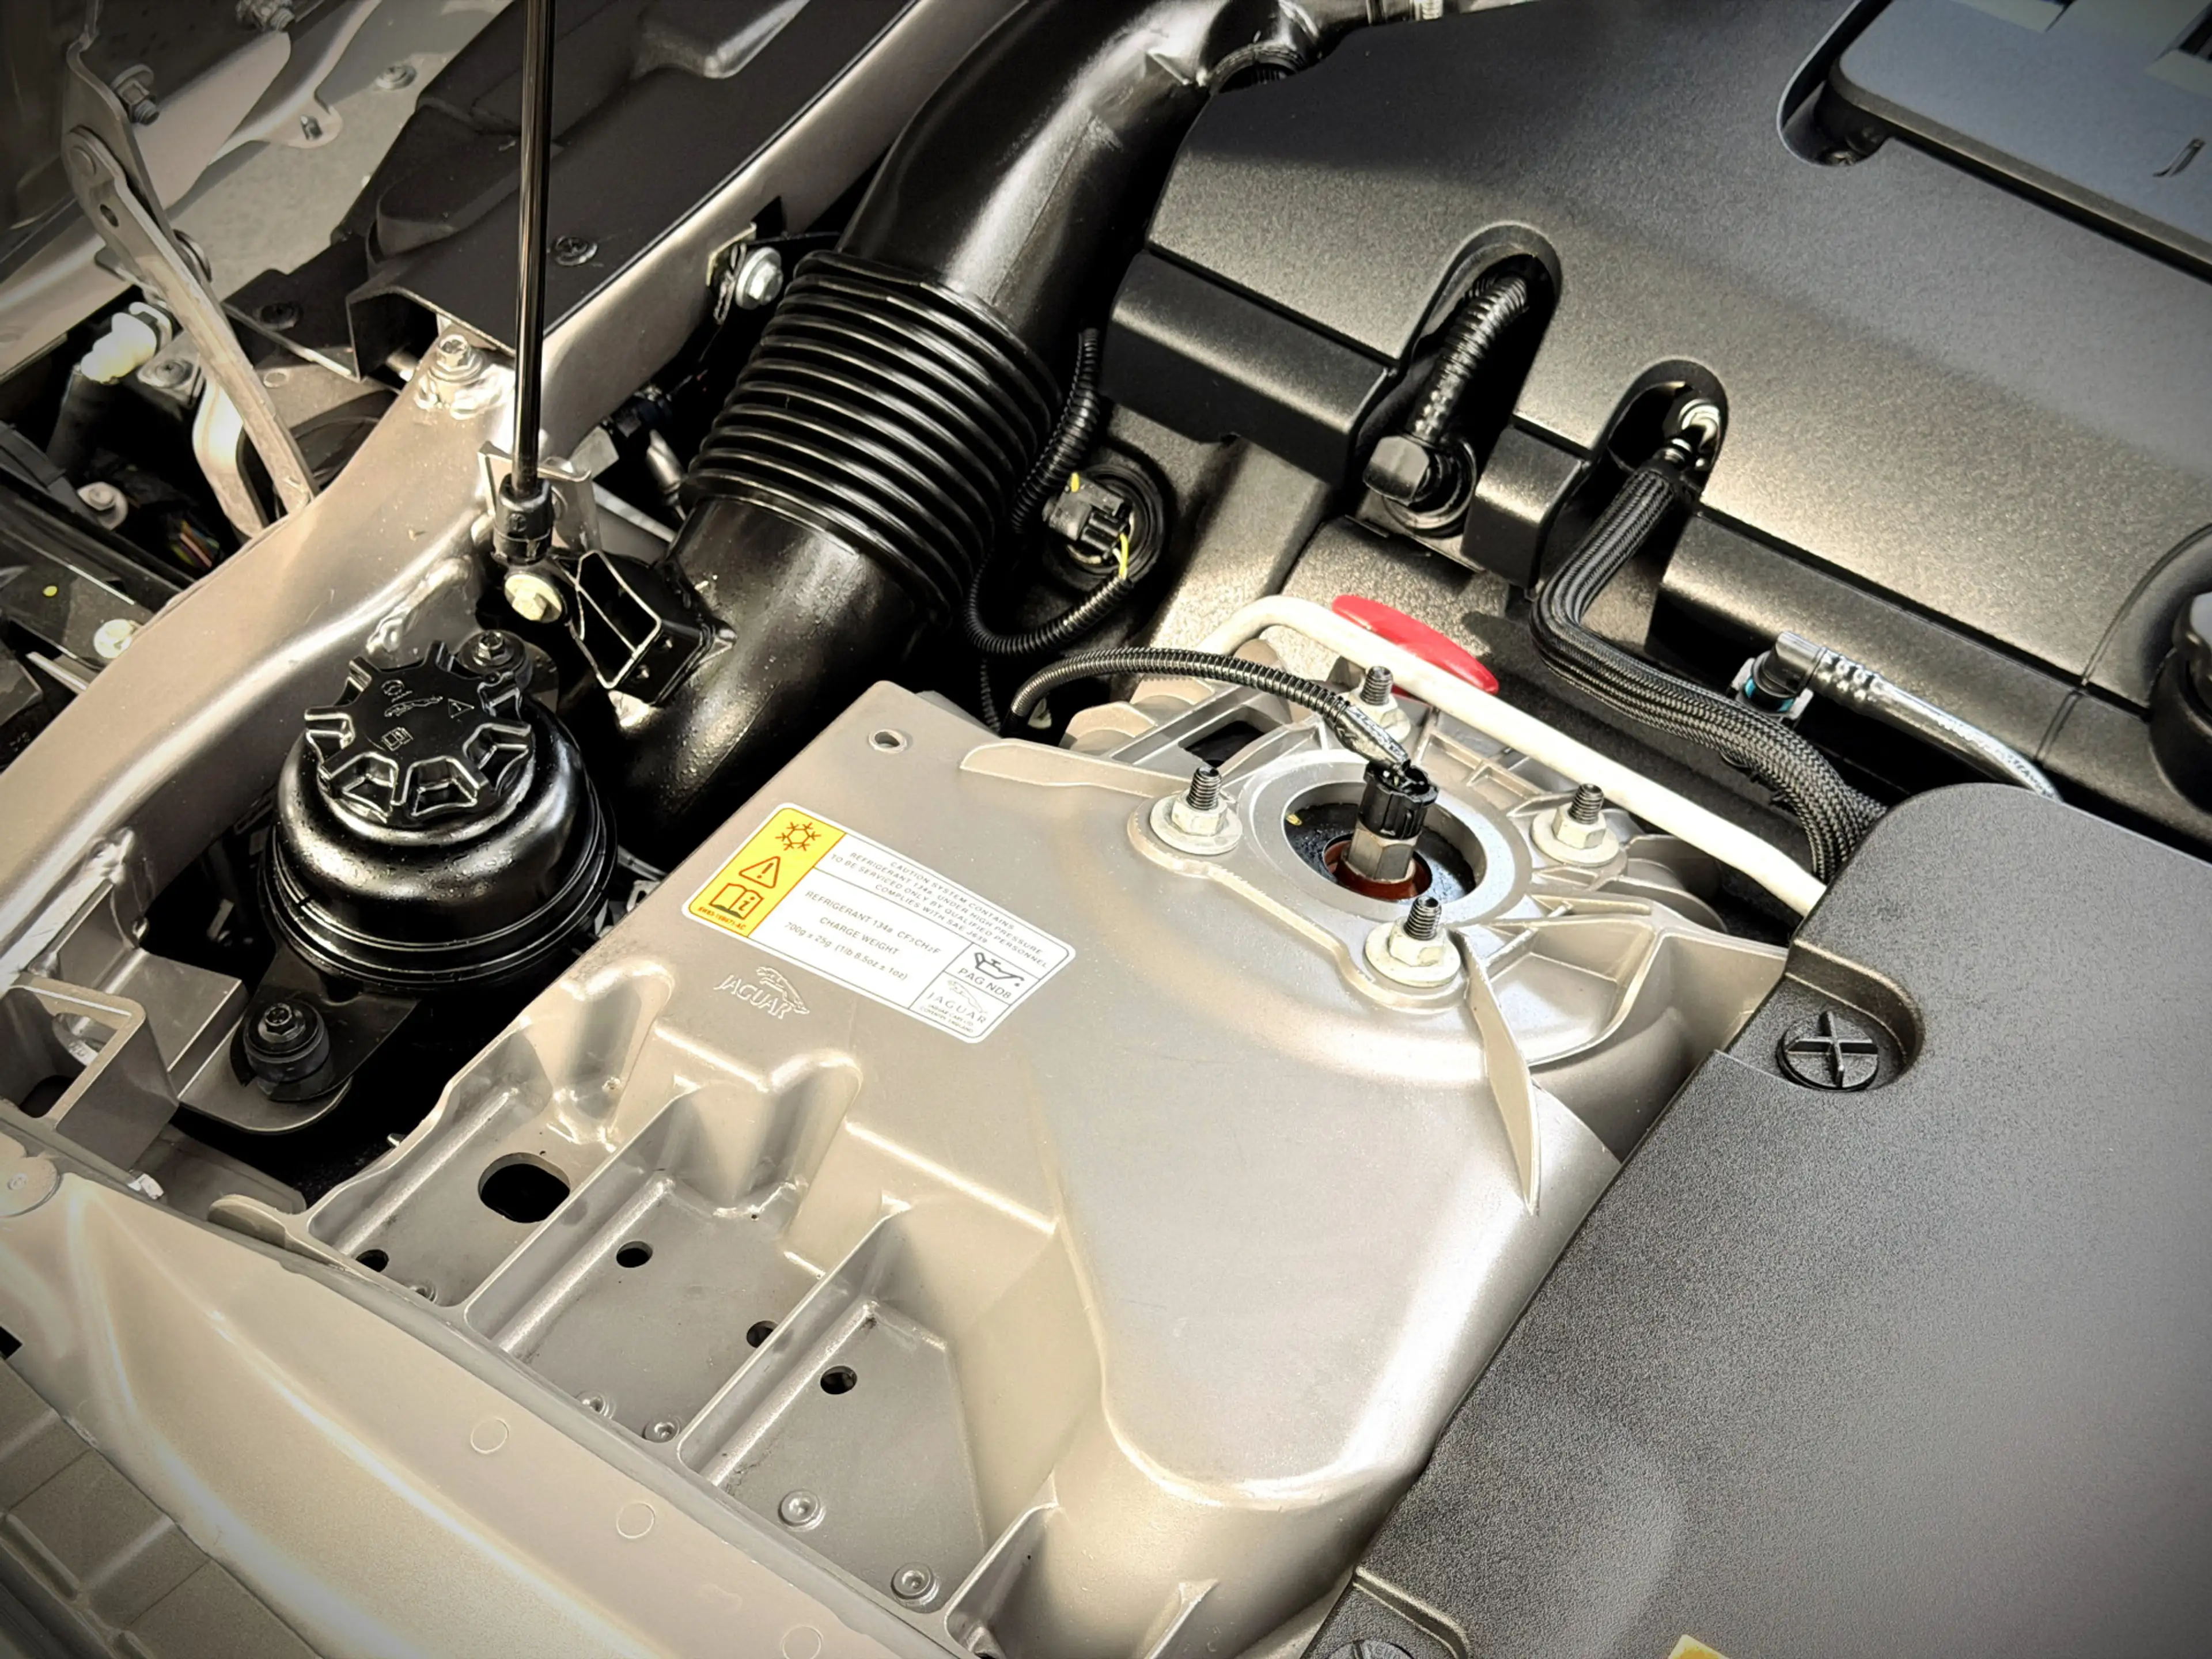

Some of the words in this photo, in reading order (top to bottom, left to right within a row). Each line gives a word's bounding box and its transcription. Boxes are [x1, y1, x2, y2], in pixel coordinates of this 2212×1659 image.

[805, 891, 872, 922] REFRIGERANT
[873, 920, 893, 933] 134a
[831, 854, 843, 863] TO
[858, 866, 903, 889] SERVICED
[904, 888, 929, 902] ONLY
[945, 908, 993, 936] QUALIFIED
[994, 935, 1046, 968] PERSONNEL
[850, 853, 912, 883] REFRIGERANT
[937, 895, 968, 914] UNDER
[969, 912, 993, 927] HIGH
[994, 926, 1043, 954] PRESSURE
[876, 885, 921, 908] COMPLIES
[923, 906, 945, 921] WITH
[946, 919, 965, 931] SAE
[891, 862, 930, 883] CAUTION
[931, 882, 967, 903] SYSTEM
[965, 903, 1014, 929] CONTAINS
[785, 922, 806, 936] 700g
[815, 935, 832, 948] 25g
[889, 967, 908, 980] 1oz)
[820, 917, 861, 938] CHARGE
[862, 934, 899, 955] WEIGHT
[713, 975, 792, 1020] JAGUAR
[957, 968, 985, 985] PAG
[986, 983, 1012, 998] ND8
[927, 992, 986, 1024] JAGUAR
